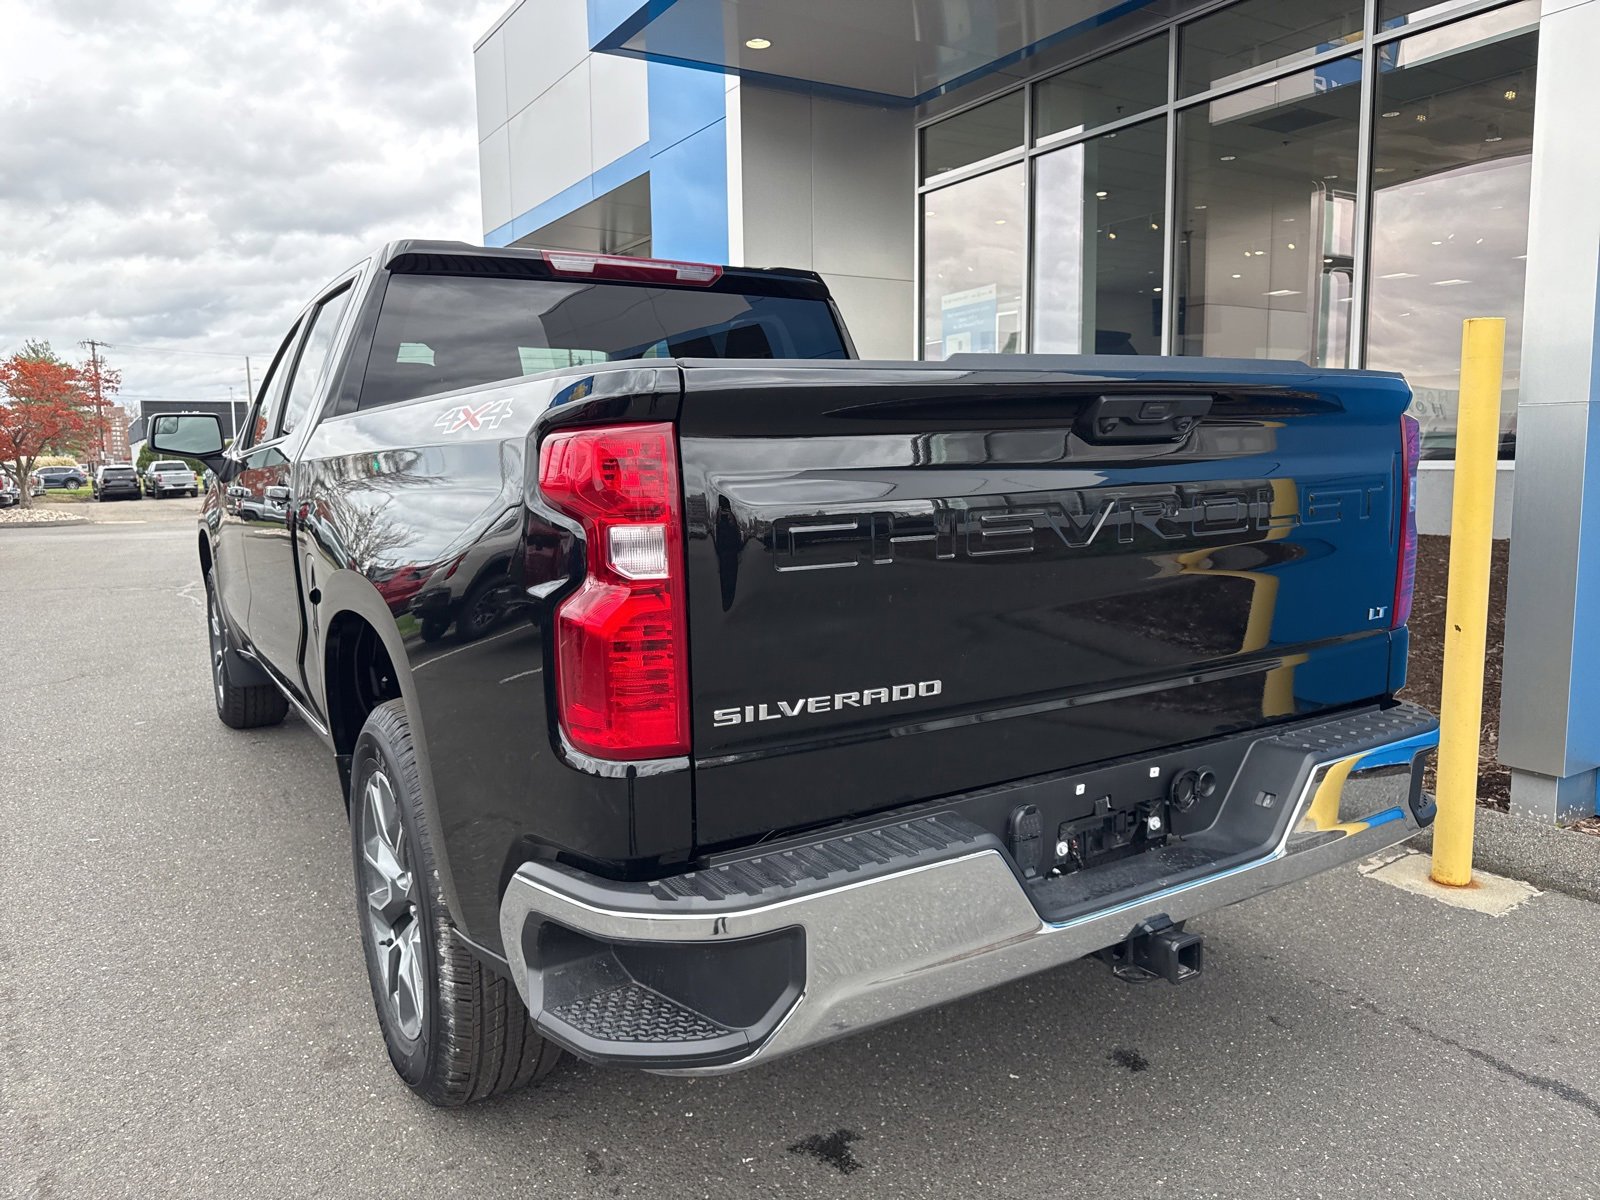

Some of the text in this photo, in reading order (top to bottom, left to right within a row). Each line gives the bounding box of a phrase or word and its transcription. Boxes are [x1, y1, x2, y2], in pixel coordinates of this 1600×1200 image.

[772, 483, 1385, 572] CHEVROLET
[1368, 606, 1388, 620] LT
[713, 679, 942, 727] SILVERADO
